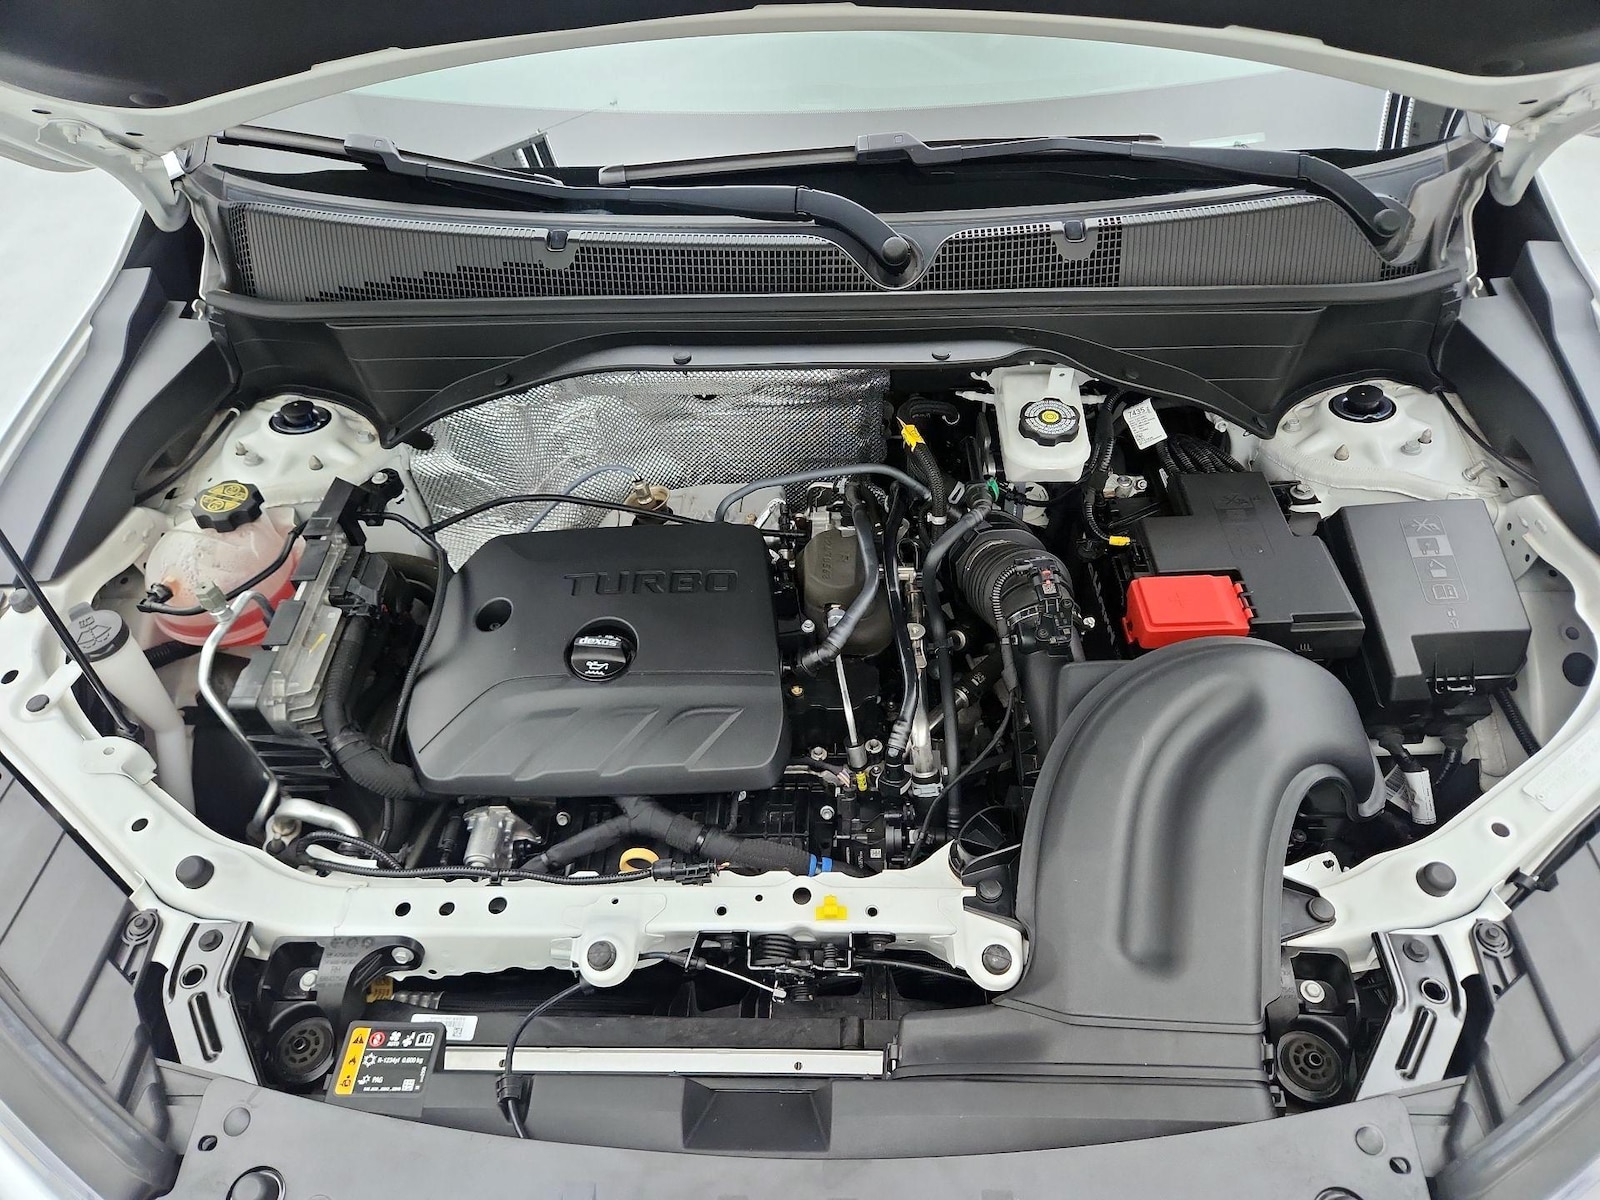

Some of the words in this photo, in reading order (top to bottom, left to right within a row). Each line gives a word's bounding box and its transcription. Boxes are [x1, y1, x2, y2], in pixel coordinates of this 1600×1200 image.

[1128, 407, 1146, 418] 7435
[563, 569, 739, 596] TURBO
[579, 636, 617, 647] dexos
